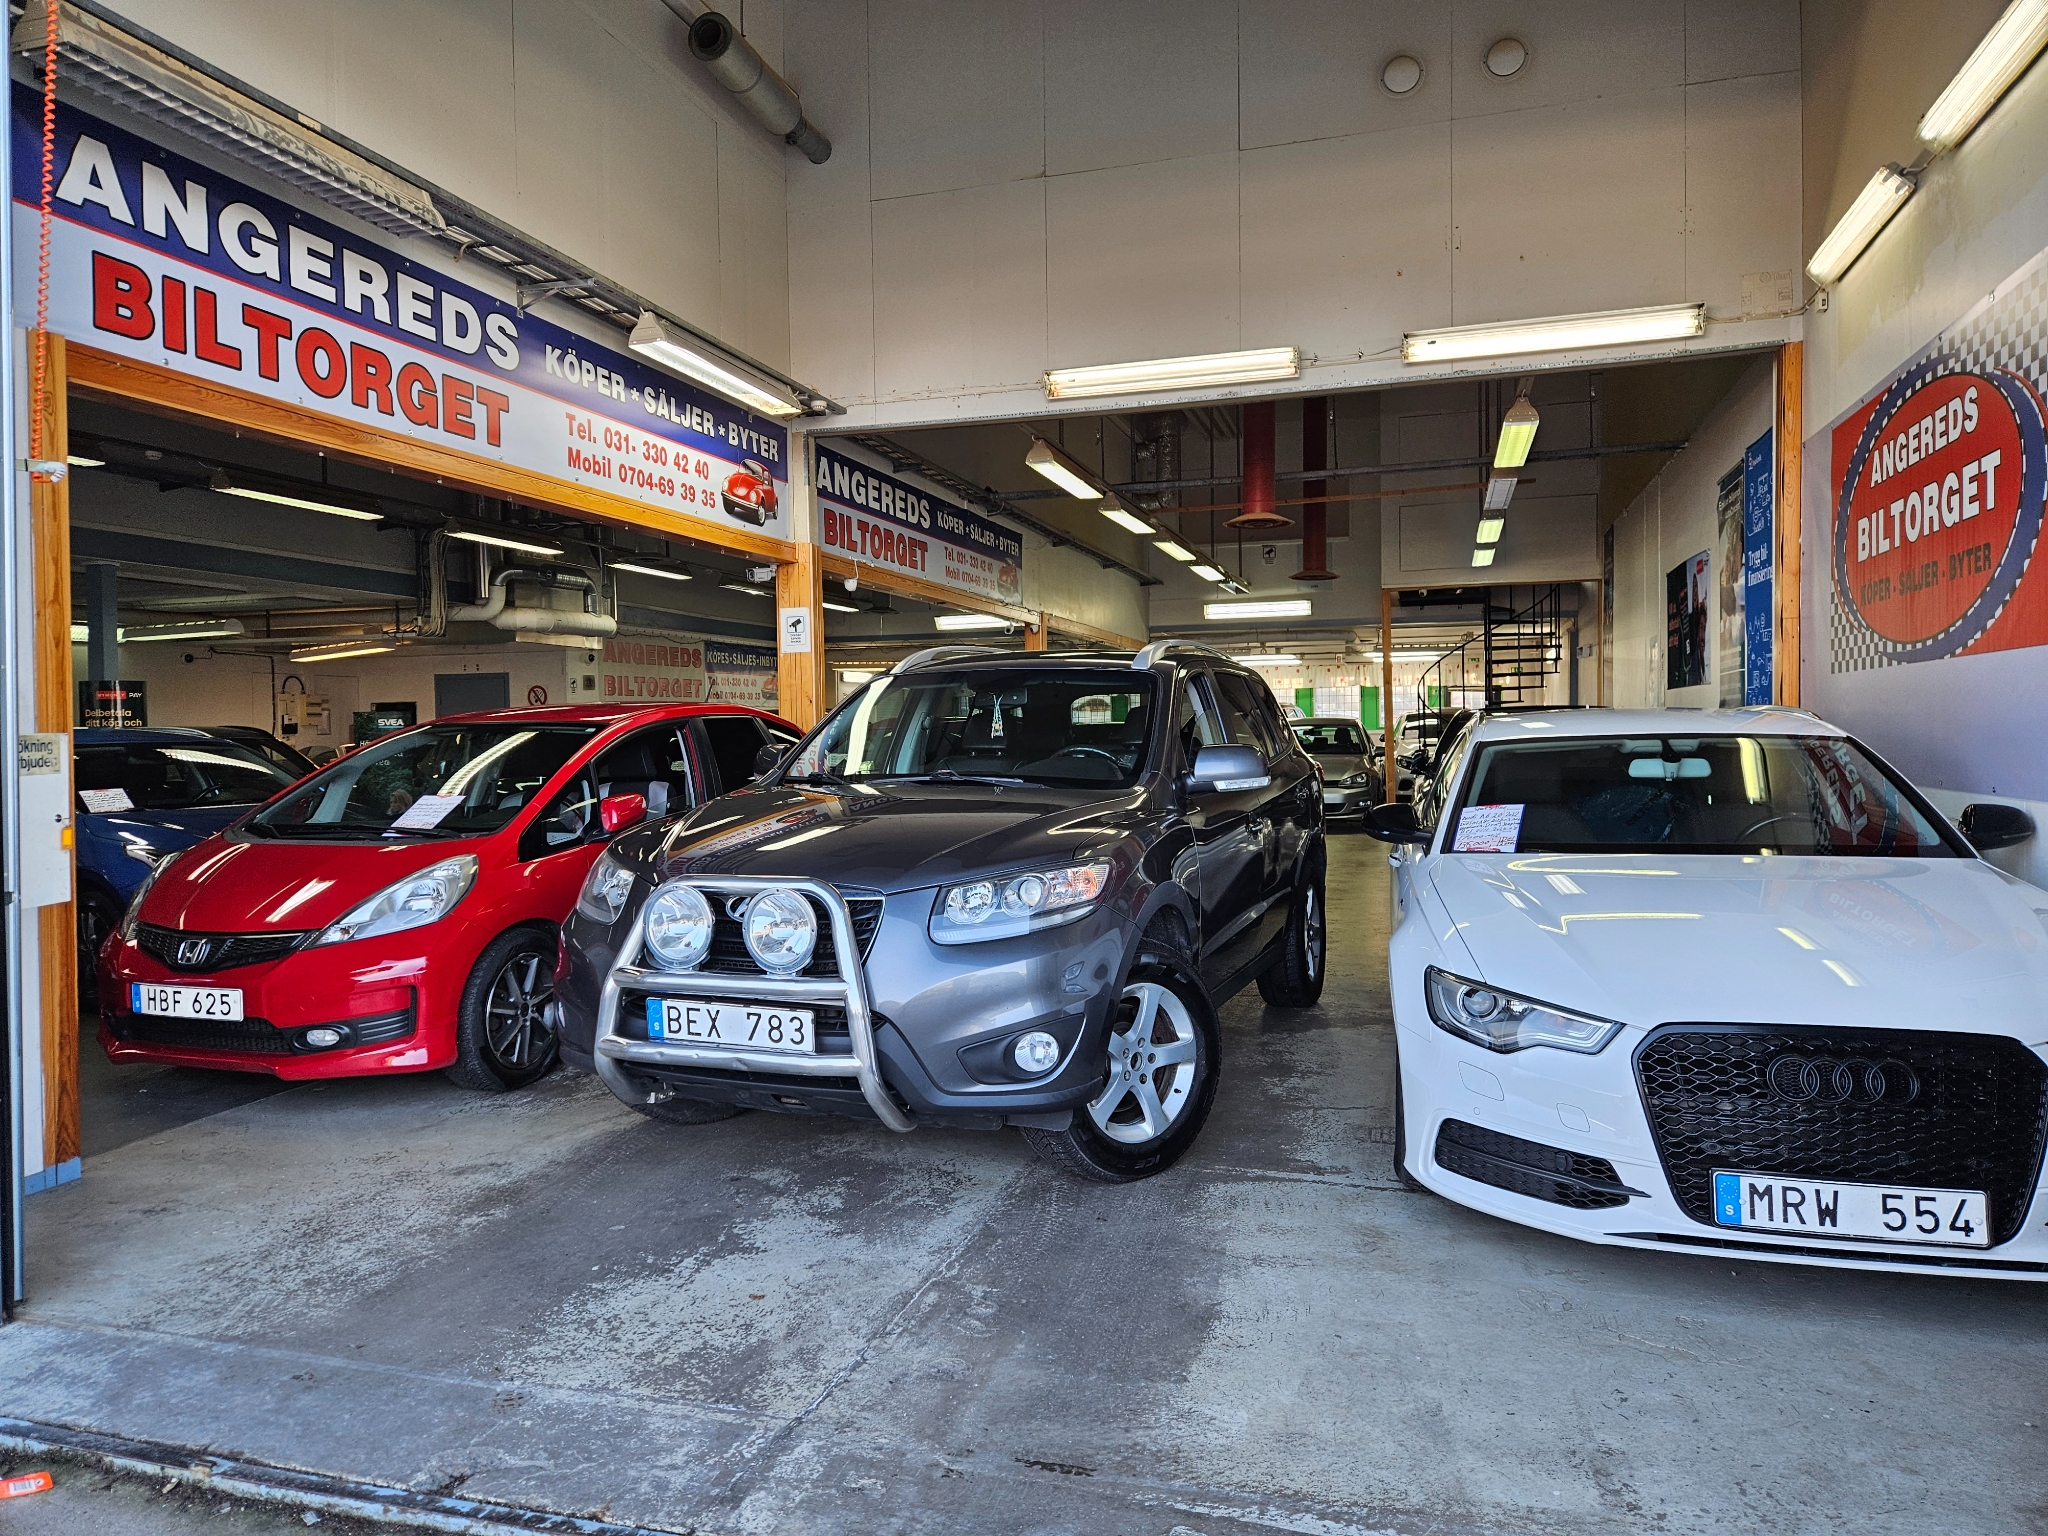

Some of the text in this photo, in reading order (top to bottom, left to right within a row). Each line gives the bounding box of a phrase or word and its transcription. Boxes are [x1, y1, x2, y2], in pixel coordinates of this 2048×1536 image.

[55, 134, 520, 371] ANGEREDS
[92, 250, 509, 447] BILTORGET
[545, 343, 778, 462] KÖPER SÄLJER BYTER
[565, 412, 709, 480] Tel. 031- 330 42 40
[1870, 385, 1979, 488] ANGEREDS
[567, 446, 716, 508] Mobil 0704-69 39 35
[816, 455, 931, 530] ANGEREDS
[1857, 448, 2001, 563] BILTORGET
[823, 507, 928, 572] BILTORGET
[937, 510, 1019, 556] KÖPER SÄLJER BYTER
[1949, 542, 1992, 581] BYTER
[603, 640, 702, 669] ANGEREDS
[85, 708, 131, 717] Delbetala
[604, 674, 702, 698] BILTORGET
[85, 719, 100, 727] ditt
[124, 718, 142, 727] och
[147, 988, 182, 1013] HBF
[192, 991, 231, 1016] 625
[653, 1005, 805, 1046] S BEX 783
[1725, 1182, 1975, 1238] S MRW 554
